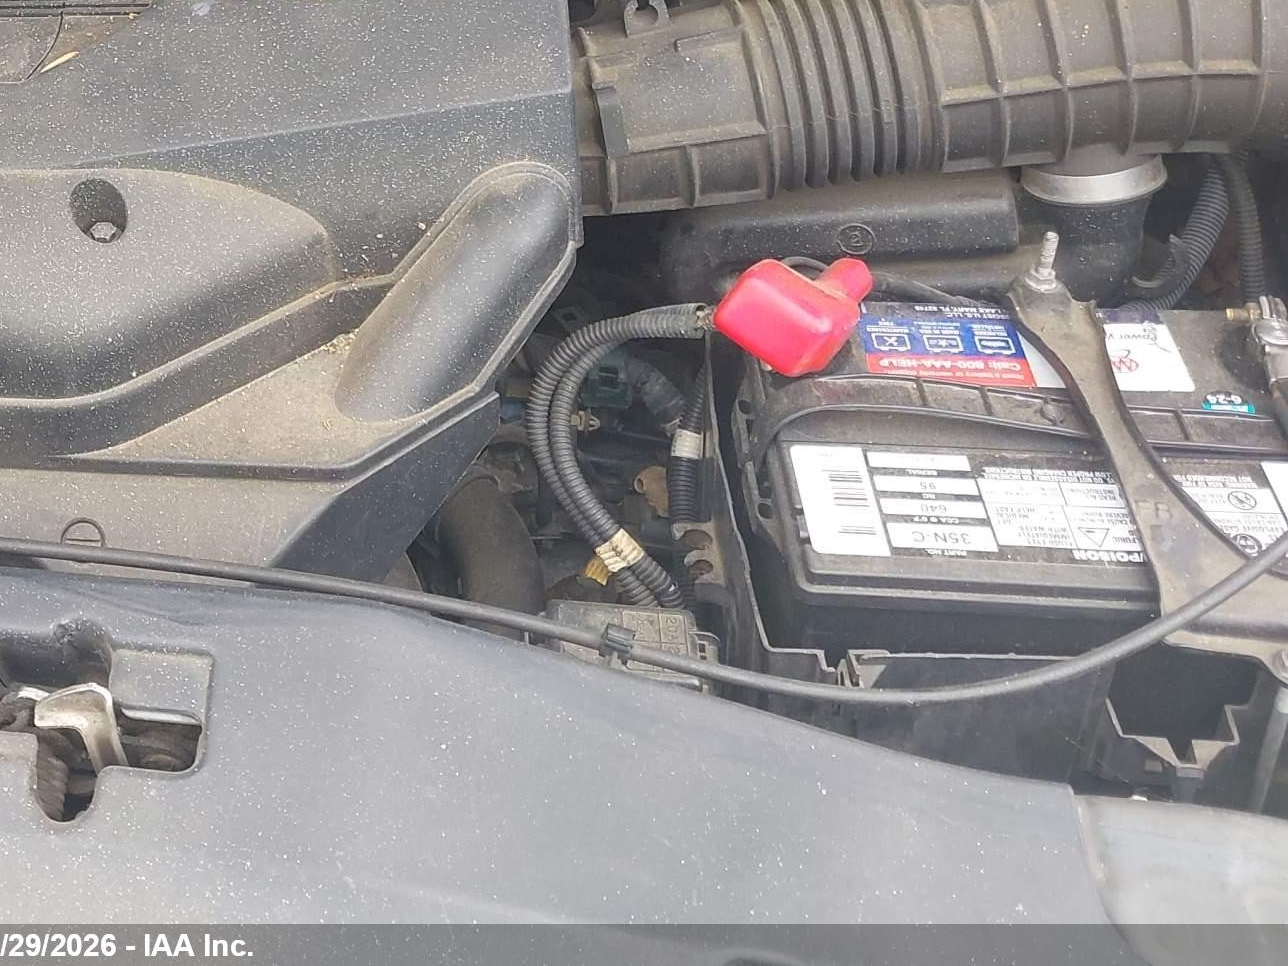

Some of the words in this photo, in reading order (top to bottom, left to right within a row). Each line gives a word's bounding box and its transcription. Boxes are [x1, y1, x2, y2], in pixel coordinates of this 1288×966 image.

[878, 358, 984, 370] 800-AAA-HELP
[920, 482, 936, 490] 95
[911, 530, 972, 545] 35N-C
